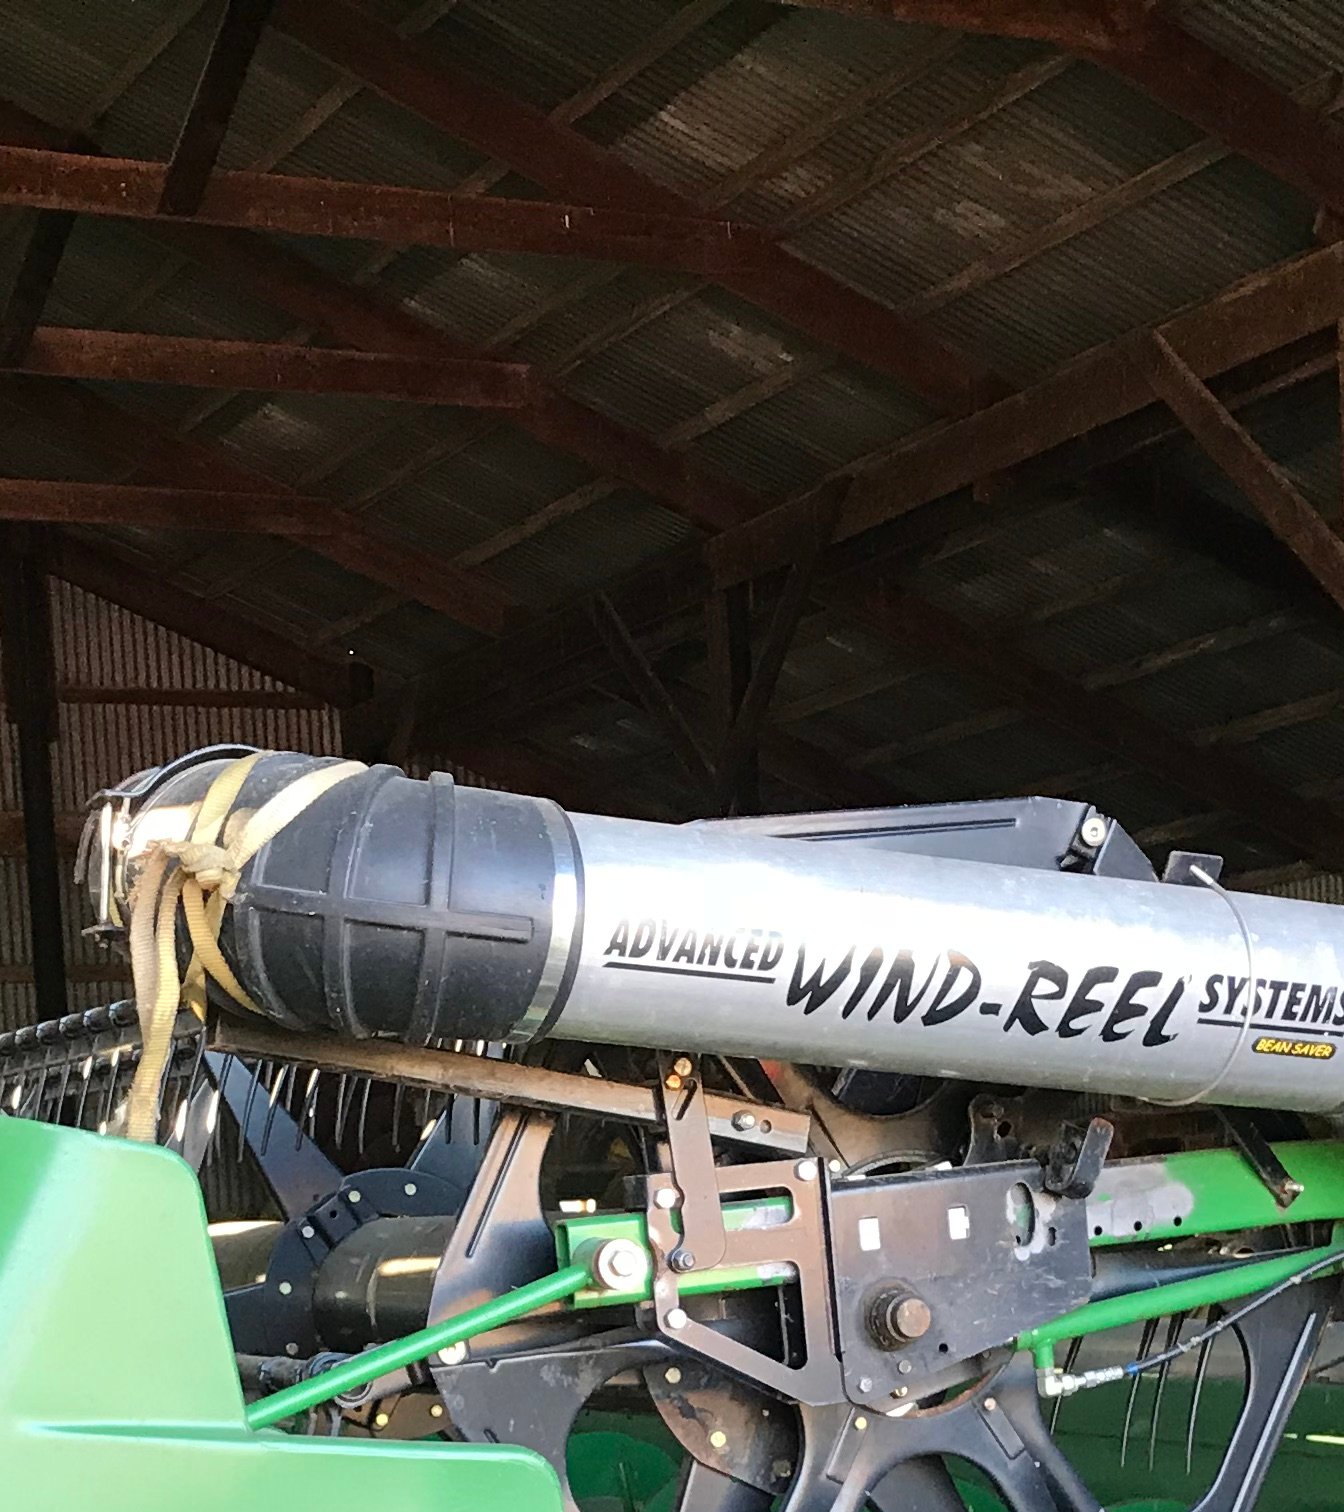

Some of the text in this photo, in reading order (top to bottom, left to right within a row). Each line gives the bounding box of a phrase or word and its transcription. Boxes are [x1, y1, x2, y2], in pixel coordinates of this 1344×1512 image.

[605, 917, 784, 972] ADVANCED
[786, 942, 1192, 1047] WIND-REEL
[1255, 1038, 1334, 1058] BEAN SAVER
